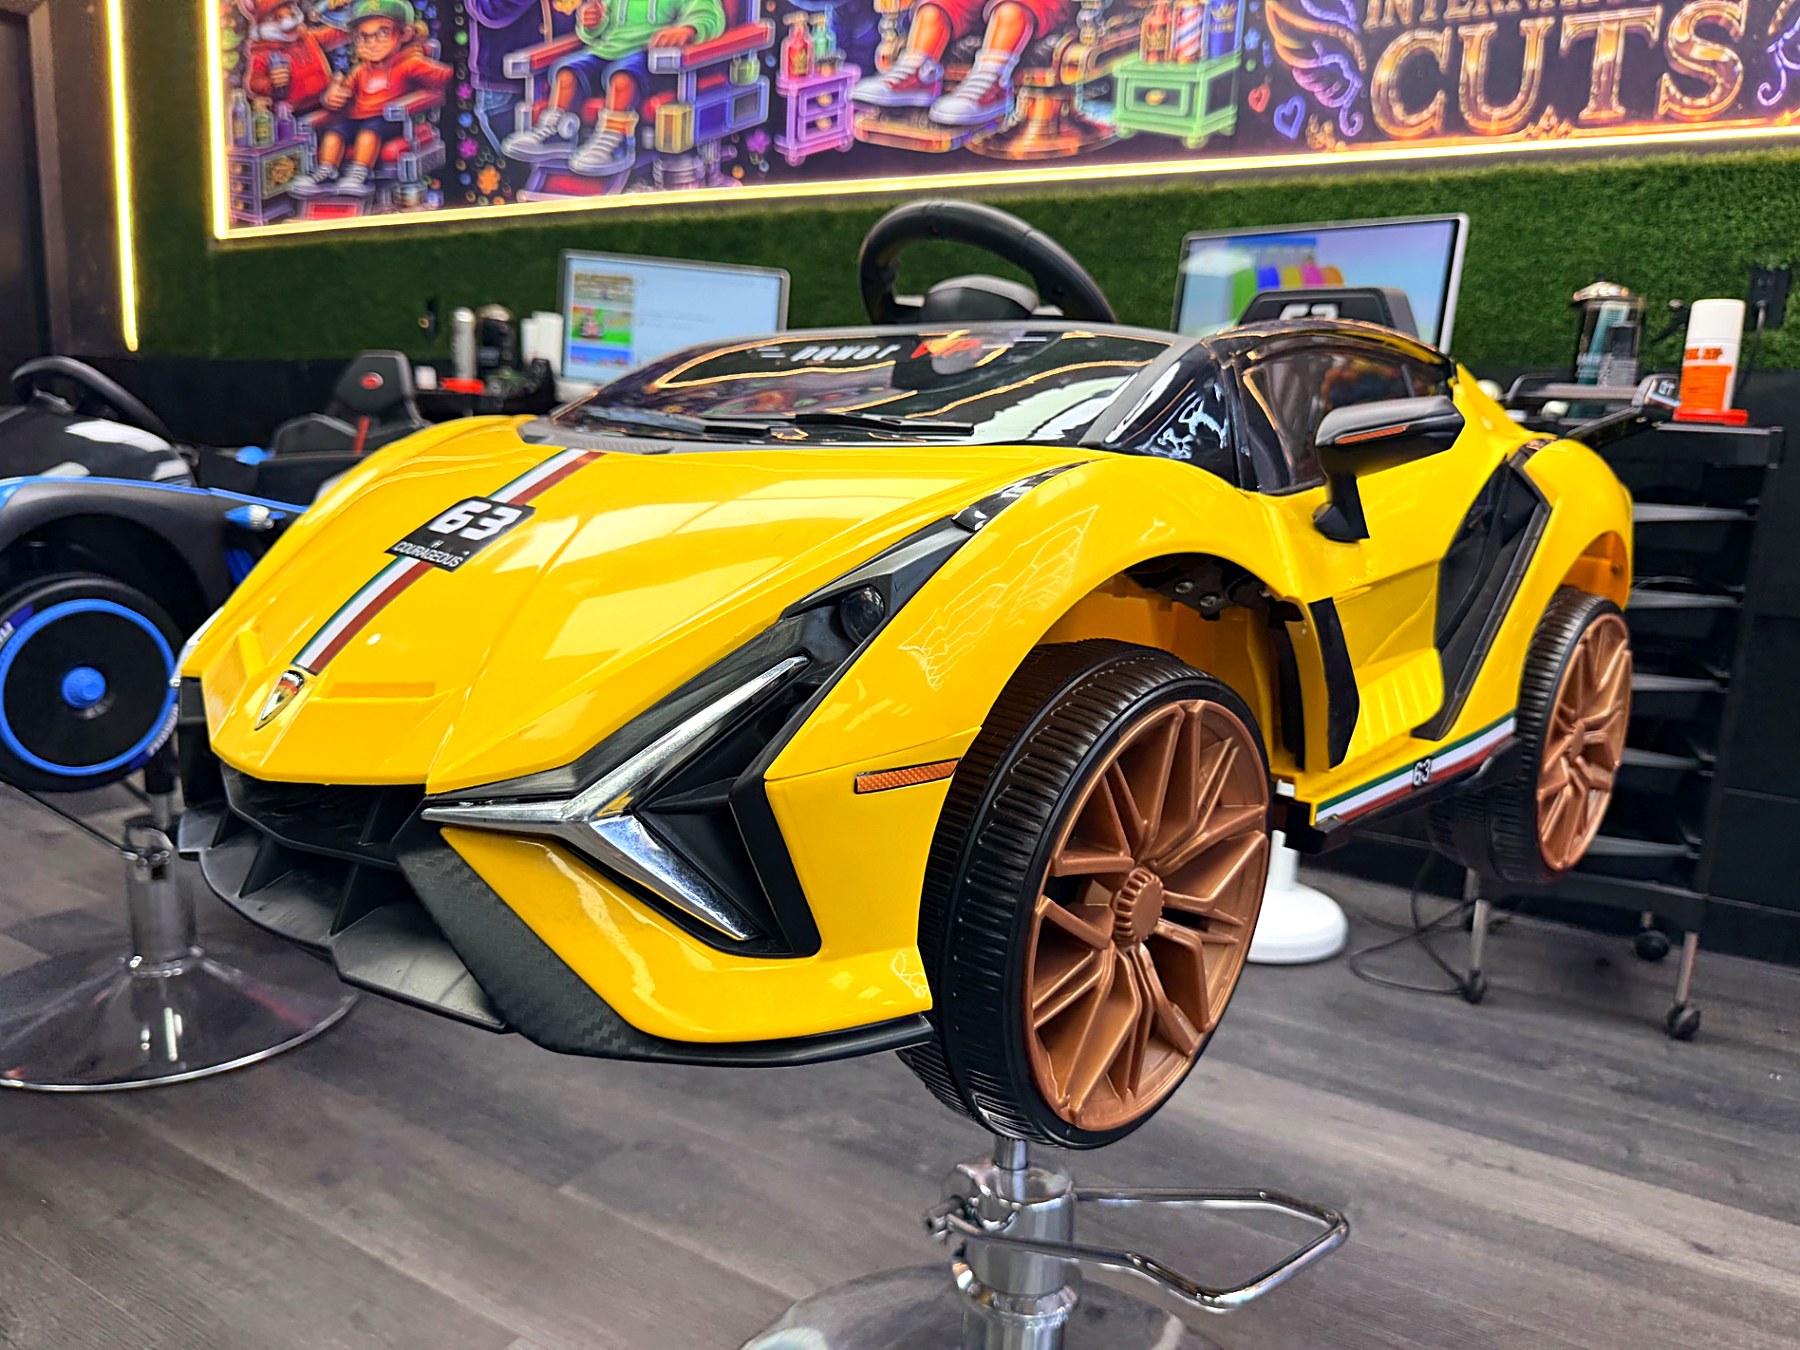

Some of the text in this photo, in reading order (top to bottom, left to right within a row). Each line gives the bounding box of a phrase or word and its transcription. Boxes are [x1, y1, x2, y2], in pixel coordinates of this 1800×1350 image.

[1370, 0, 1748, 138] CUTS
[427, 500, 523, 541] 63
[394, 541, 464, 568] COURAGEOUS
[1413, 758, 1431, 786] 63
